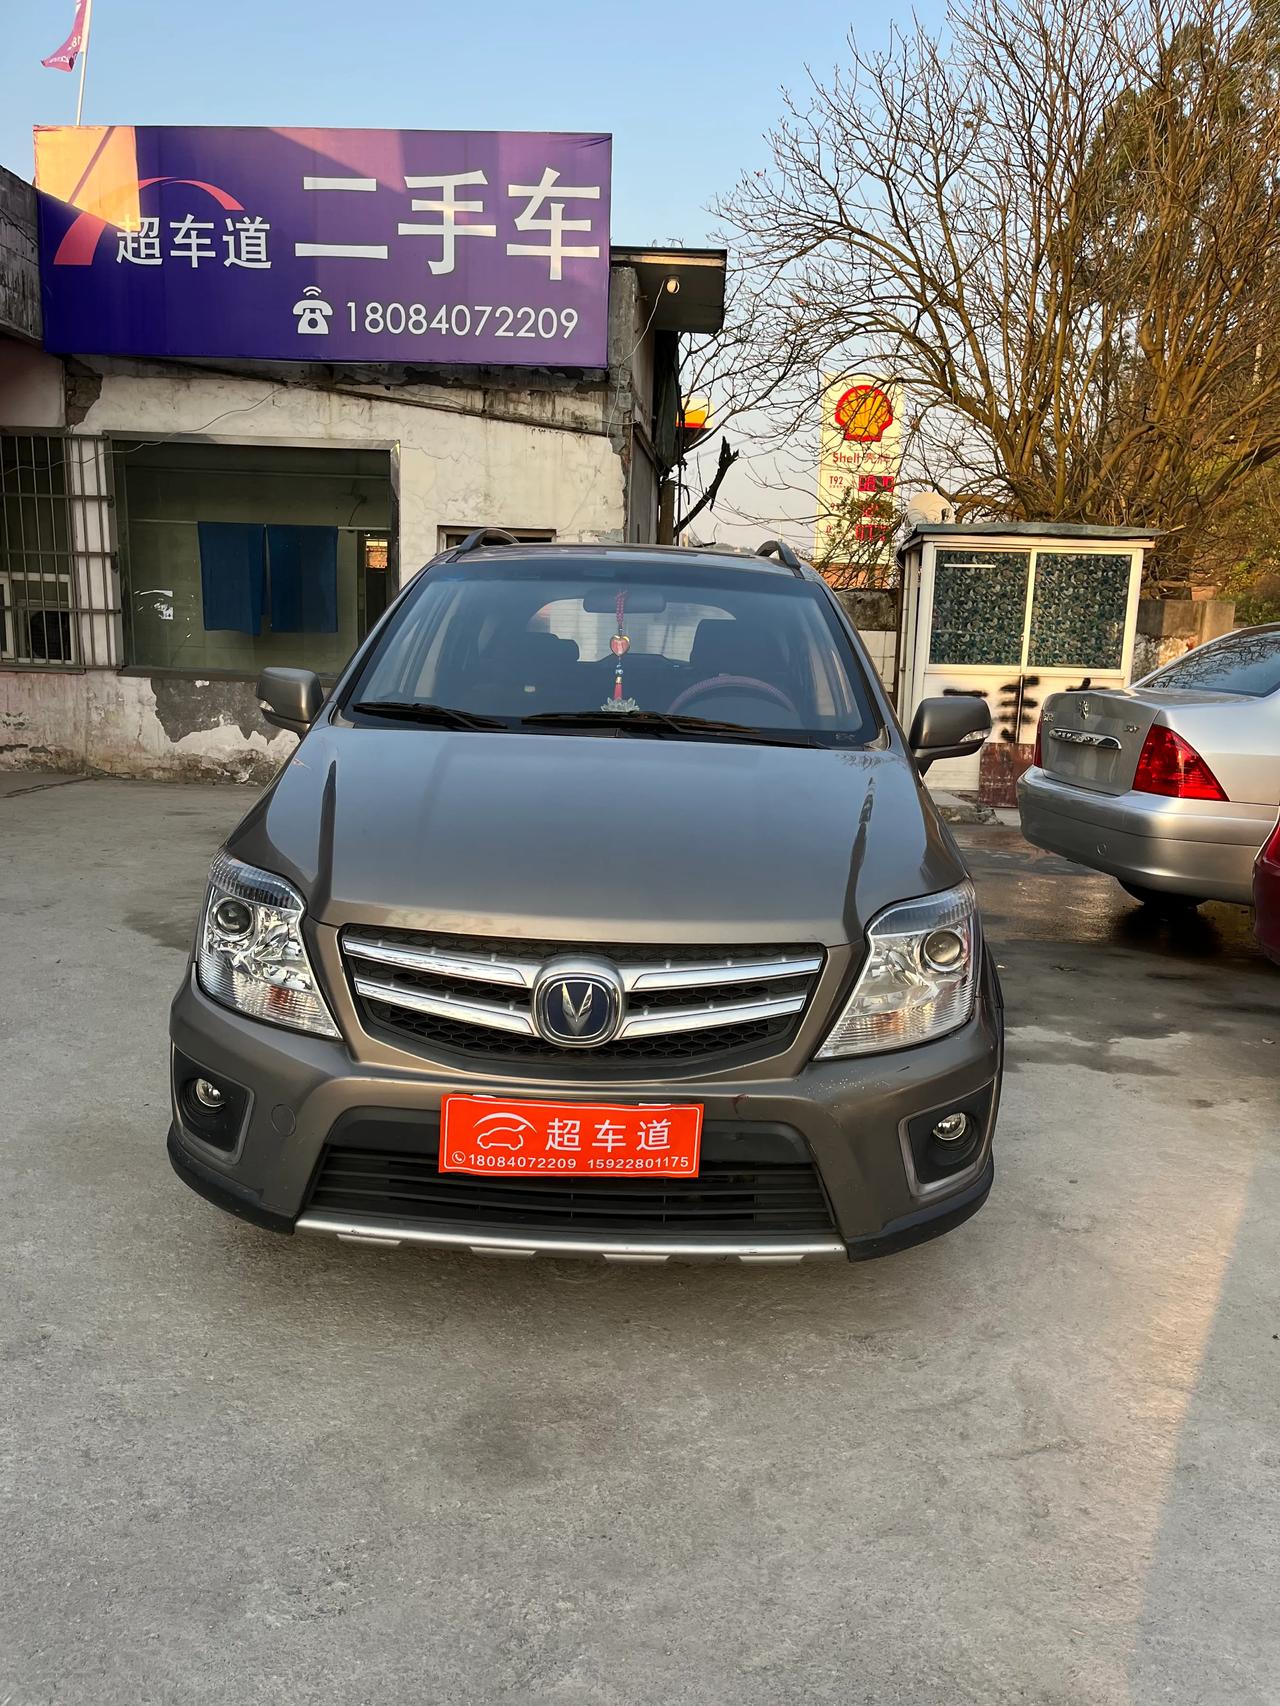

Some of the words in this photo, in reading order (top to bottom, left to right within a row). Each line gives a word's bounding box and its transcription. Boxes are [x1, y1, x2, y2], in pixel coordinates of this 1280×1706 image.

[115, 213, 272, 269] 超车道
[295, 166, 600, 281] 二手车
[346, 301, 579, 339] 18084072209
[832, 452, 860, 464] Shell
[829, 475, 844, 485] T92
[545, 1117, 672, 1153] 超车道
[468, 1154, 577, 1169] 18084072209
[587, 1156, 689, 1169] 15922801175
